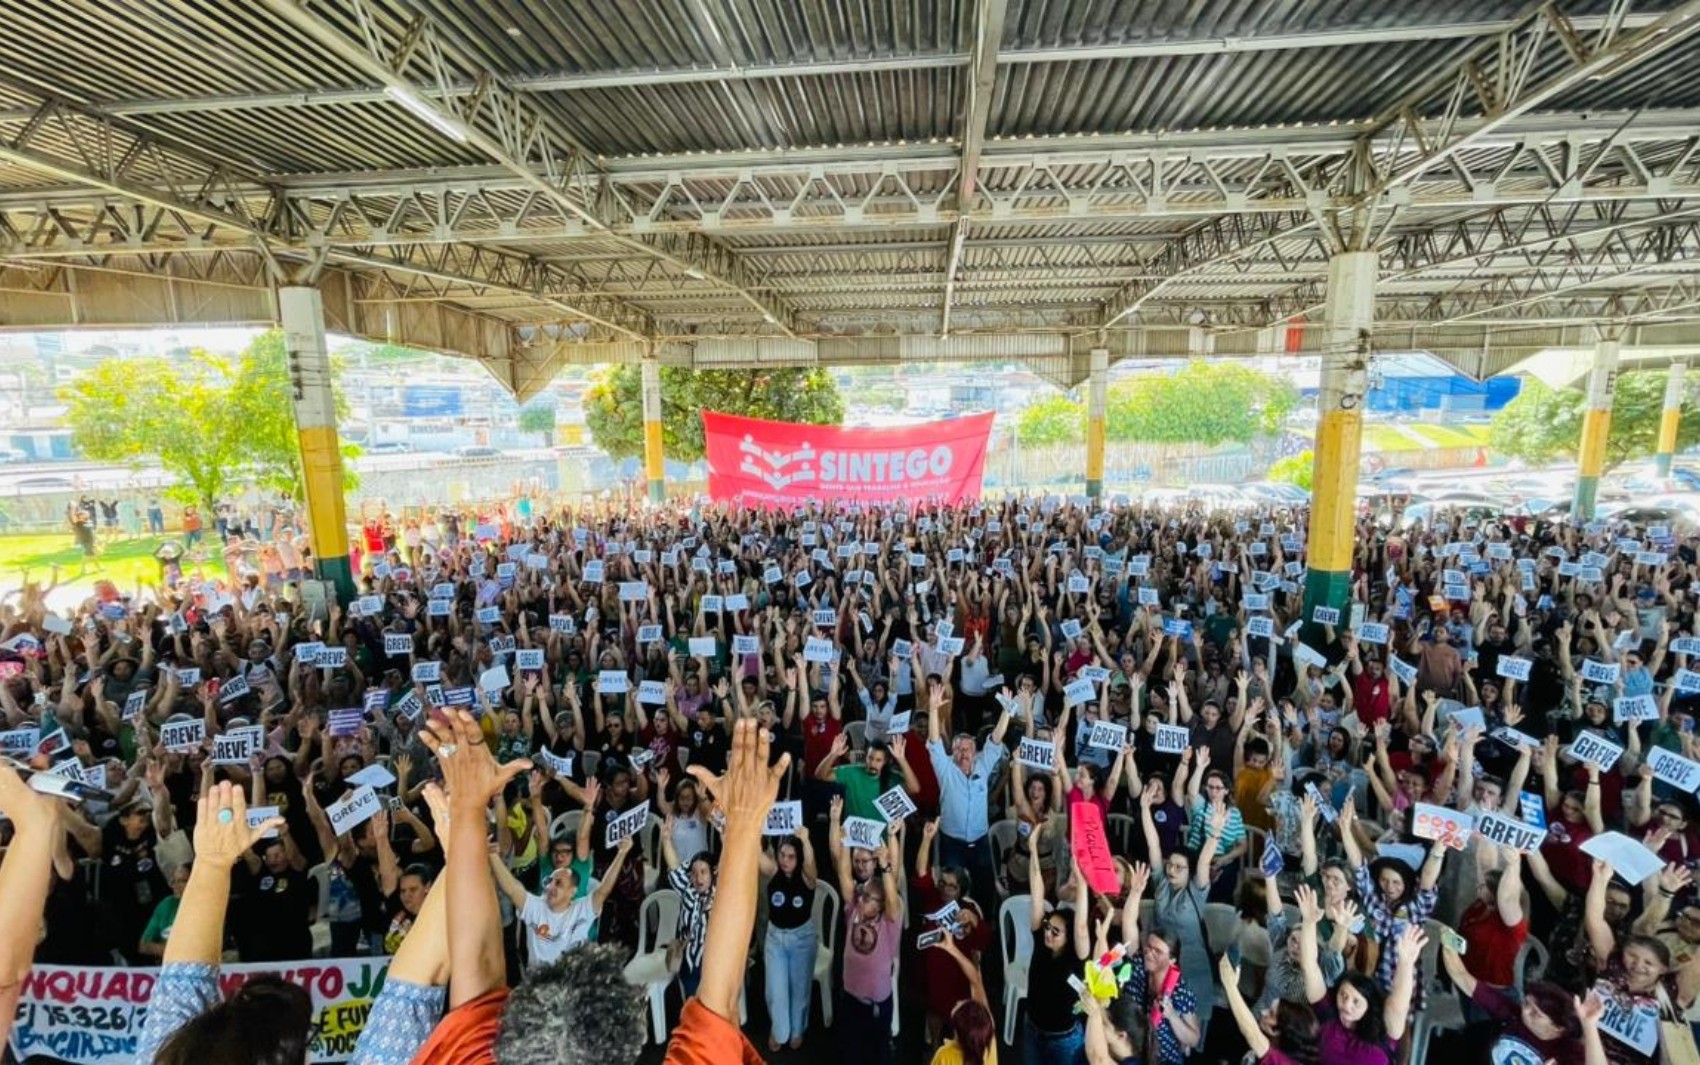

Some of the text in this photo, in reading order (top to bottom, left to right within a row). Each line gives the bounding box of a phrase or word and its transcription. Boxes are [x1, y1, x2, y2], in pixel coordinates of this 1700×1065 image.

[820, 446, 953, 483] SINTEGO
[387, 638, 411, 650] GREVE
[316, 652, 345, 664] GREVE
[1587, 662, 1615, 680] GREVE
[1619, 699, 1648, 717] GREVE
[163, 724, 202, 746] GREVE
[1091, 725, 1122, 748] GREVE
[1157, 729, 1187, 749] GREVE
[1019, 742, 1052, 766] GREVE
[1573, 736, 1617, 767] GREVE
[1654, 754, 1694, 786] GREVE
[331, 791, 376, 824] GREVE!
[878, 789, 910, 820] GREVE
[608, 807, 647, 842] GREVE
[767, 805, 796, 832] GREVE
[1479, 814, 1539, 851] GREVE
[1601, 999, 1648, 1044] GREVE
